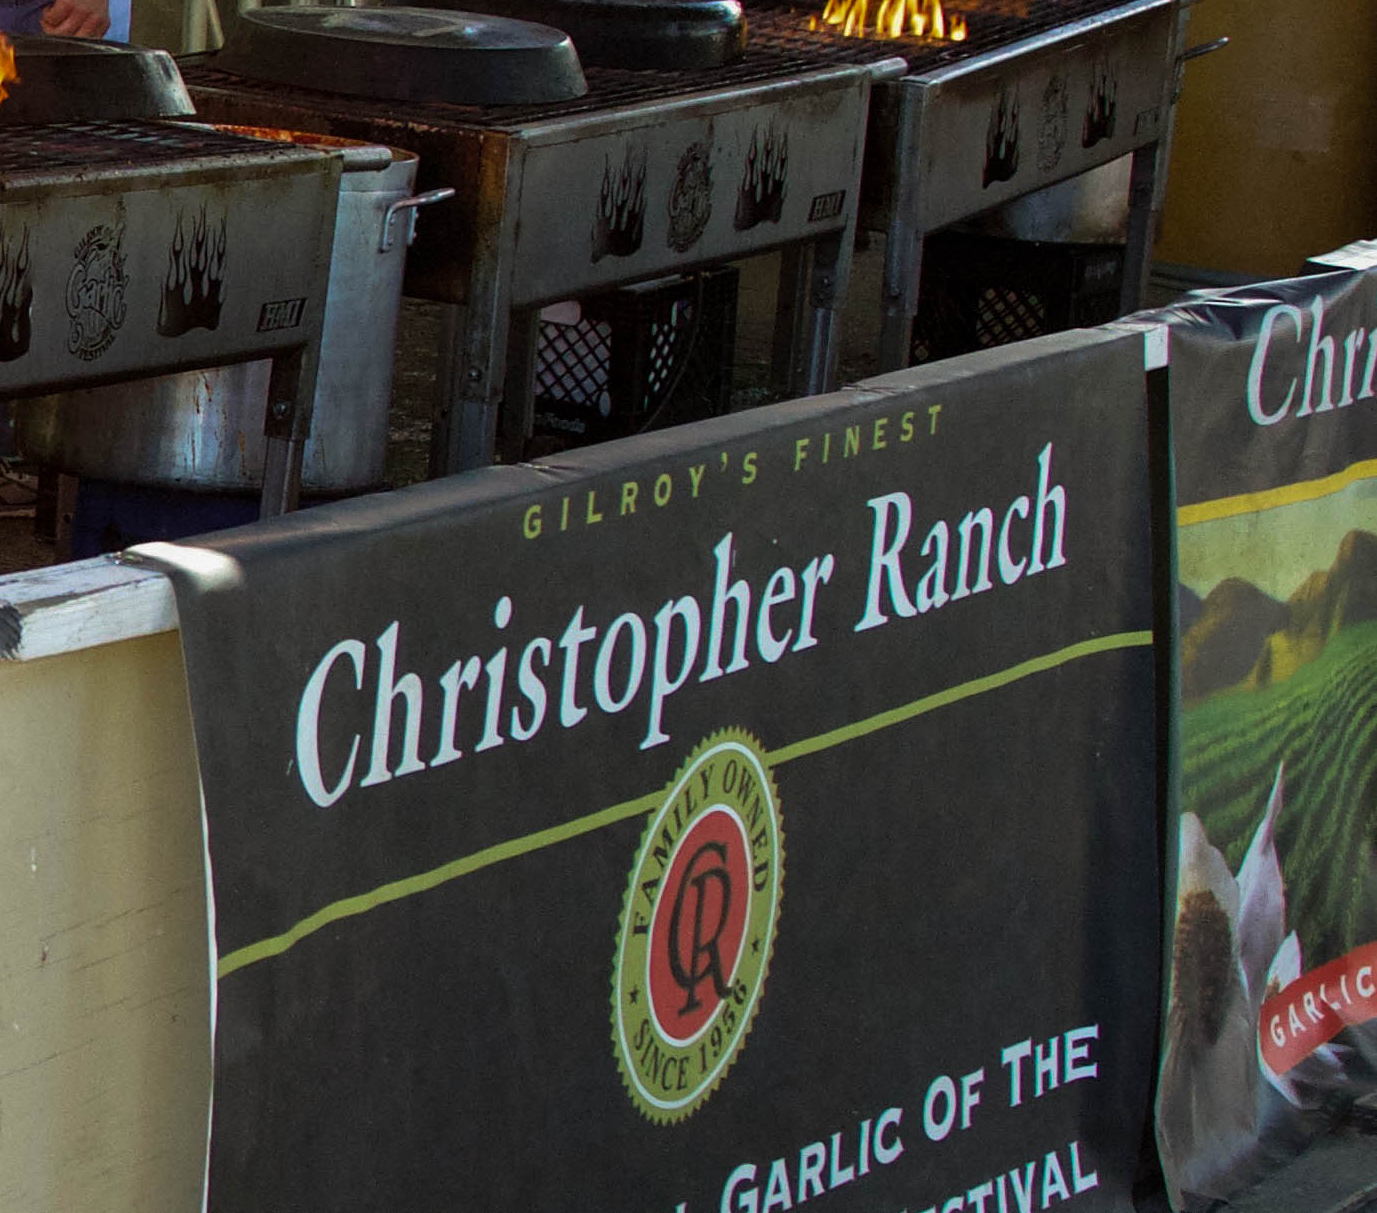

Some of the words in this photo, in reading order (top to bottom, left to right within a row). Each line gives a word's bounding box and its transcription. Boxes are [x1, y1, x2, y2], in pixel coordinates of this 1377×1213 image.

[523, 451, 758, 540] GILROY'S
[794, 404, 942, 472] FINEST
[295, 532, 835, 810] Christopher
[853, 441, 1067, 635] Ranch
[632, 761, 715, 936] FAMILY
[722, 759, 770, 893] OWNED
[633, 1018, 689, 1091] SINCE
[1270, 965, 1376, 1048] GARLIC
[720, 1107, 903, 1213] GARLIC
[923, 1067, 985, 1142] OF
[1001, 1023, 1099, 1108] THE
